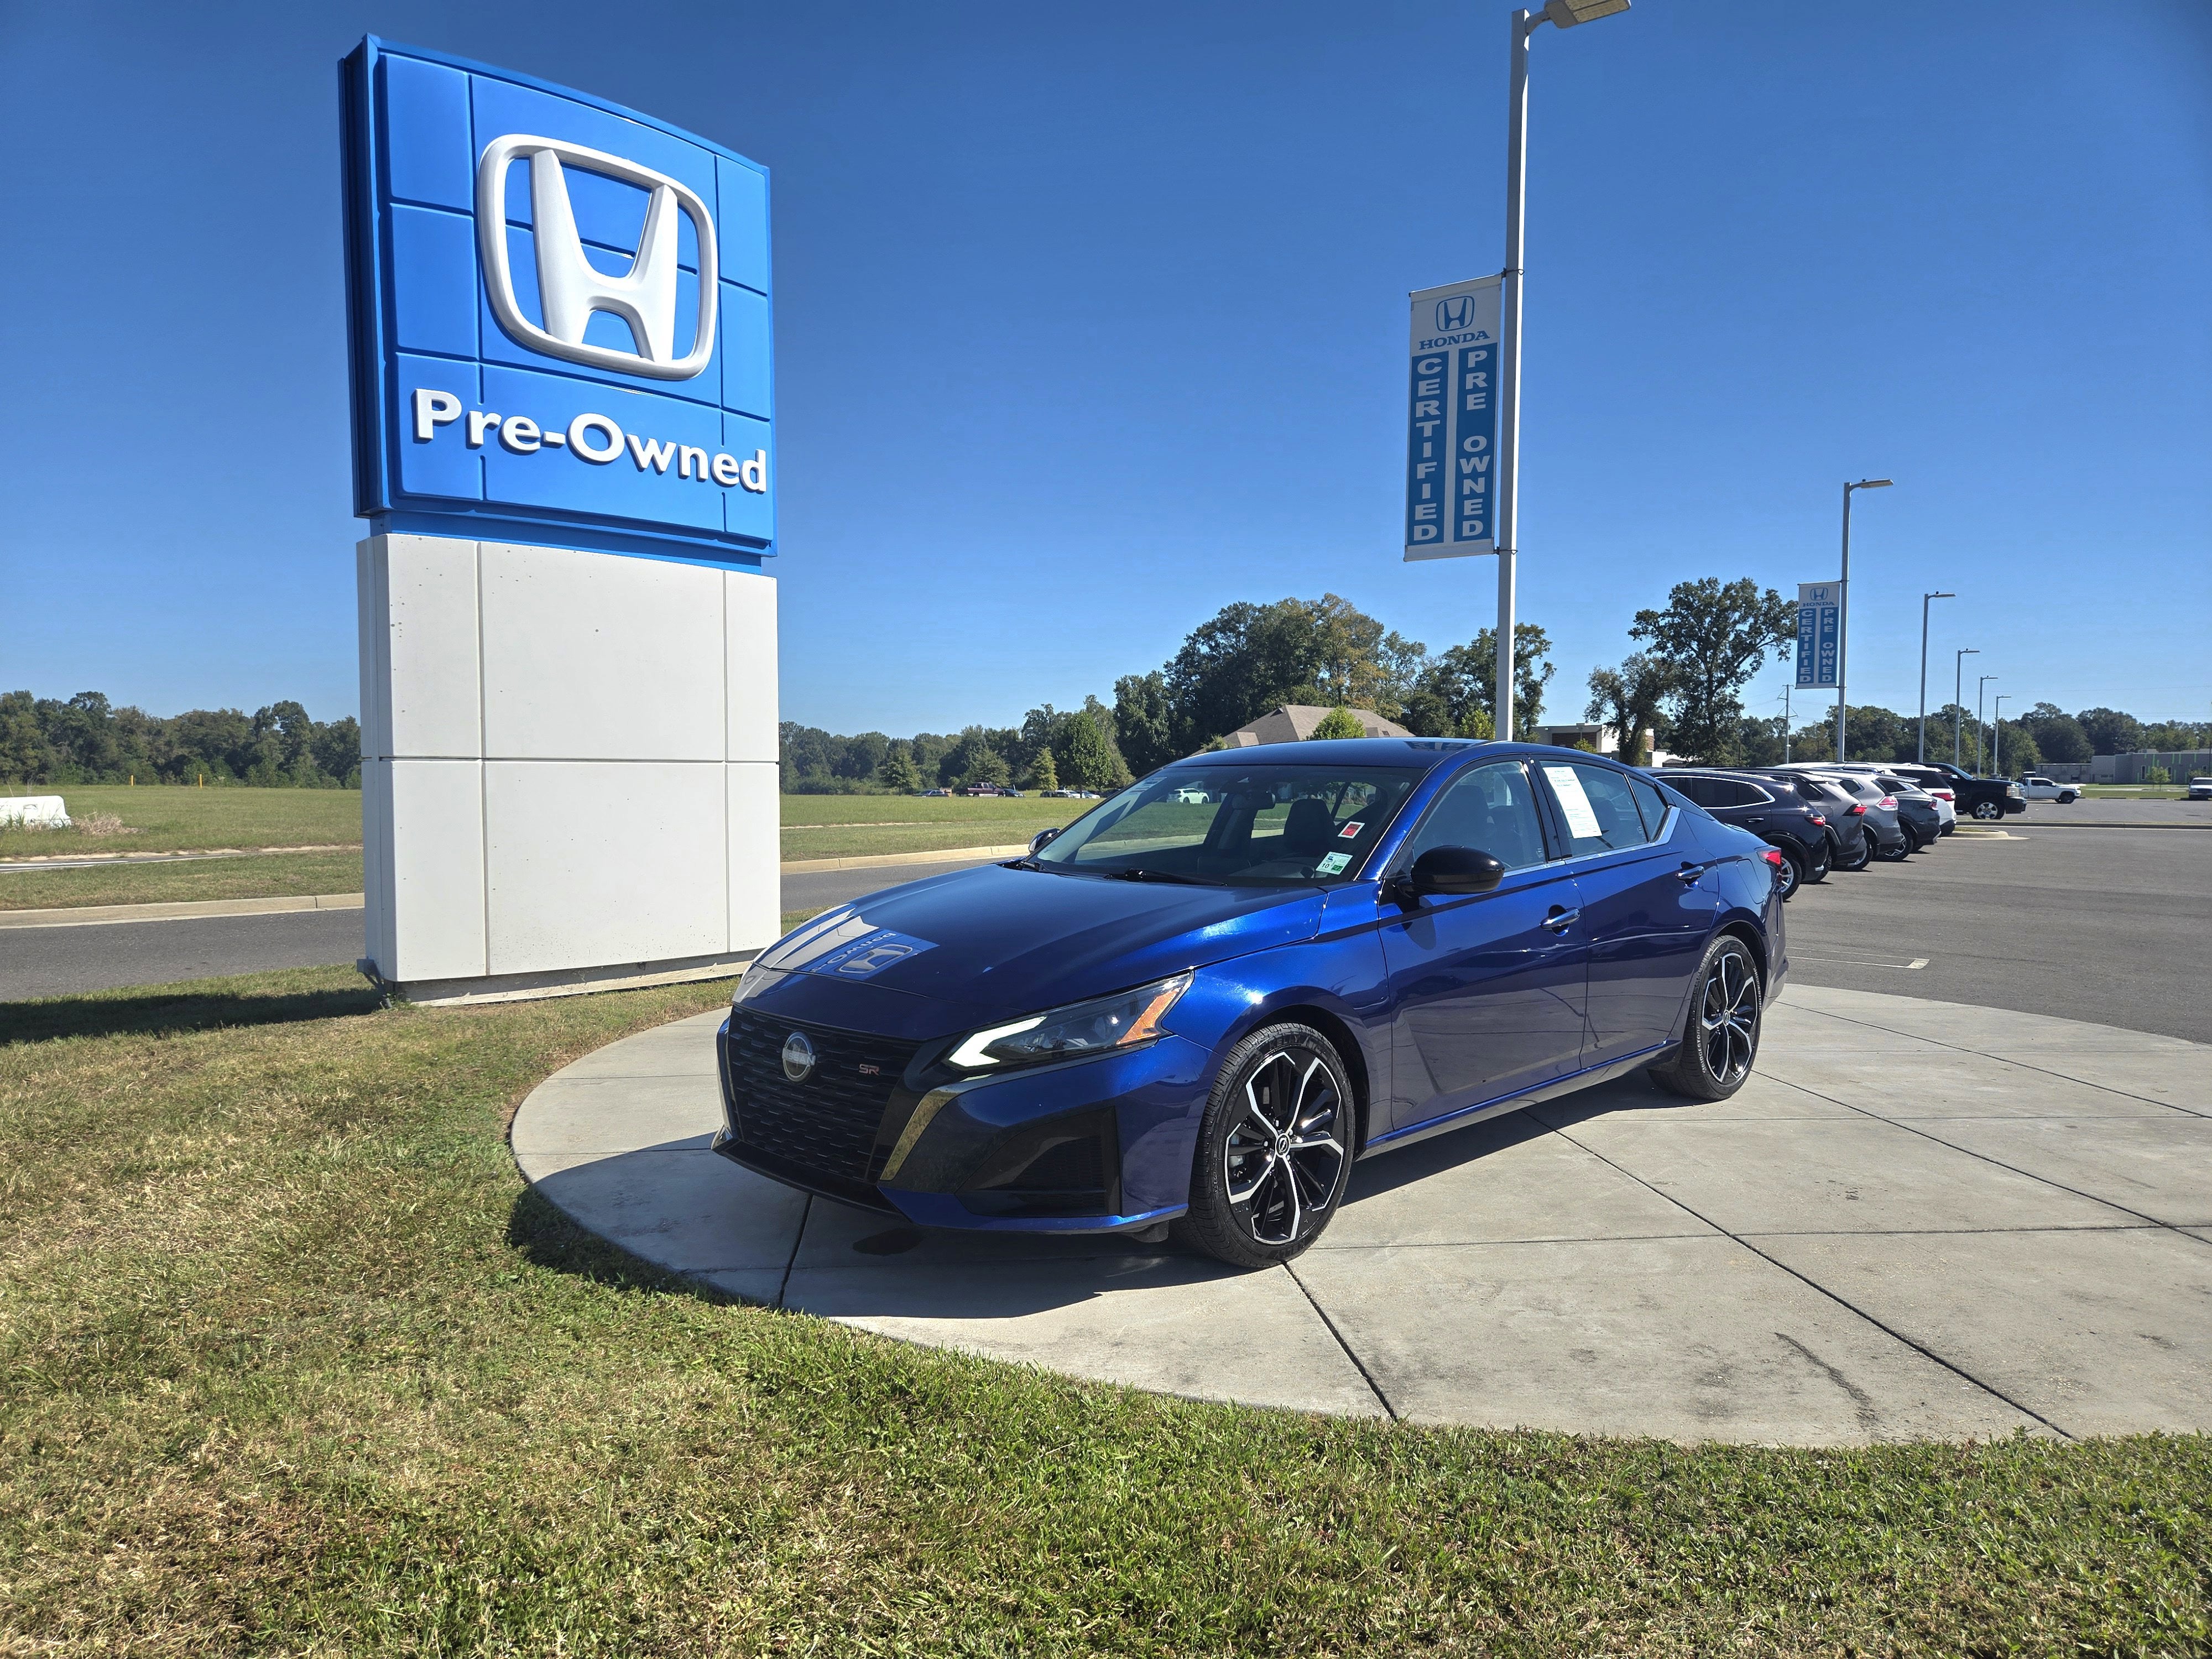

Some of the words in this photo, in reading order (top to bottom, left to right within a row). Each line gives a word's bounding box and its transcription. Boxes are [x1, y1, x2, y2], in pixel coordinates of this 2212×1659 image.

[1419, 331, 1490, 349] HONDA
[1466, 350, 1487, 410] PRE
[414, 388, 767, 492] Pre-Owned
[1413, 358, 1443, 541] CERTIFIED
[1460, 435, 1490, 537] OWNED
[1824, 609, 1834, 632] PRE
[1799, 610, 1814, 682] CERTIFIED
[1821, 642, 1835, 681] OWNED
[782, 1048, 815, 1066] NISSAN
[859, 1063, 880, 1076] SR
